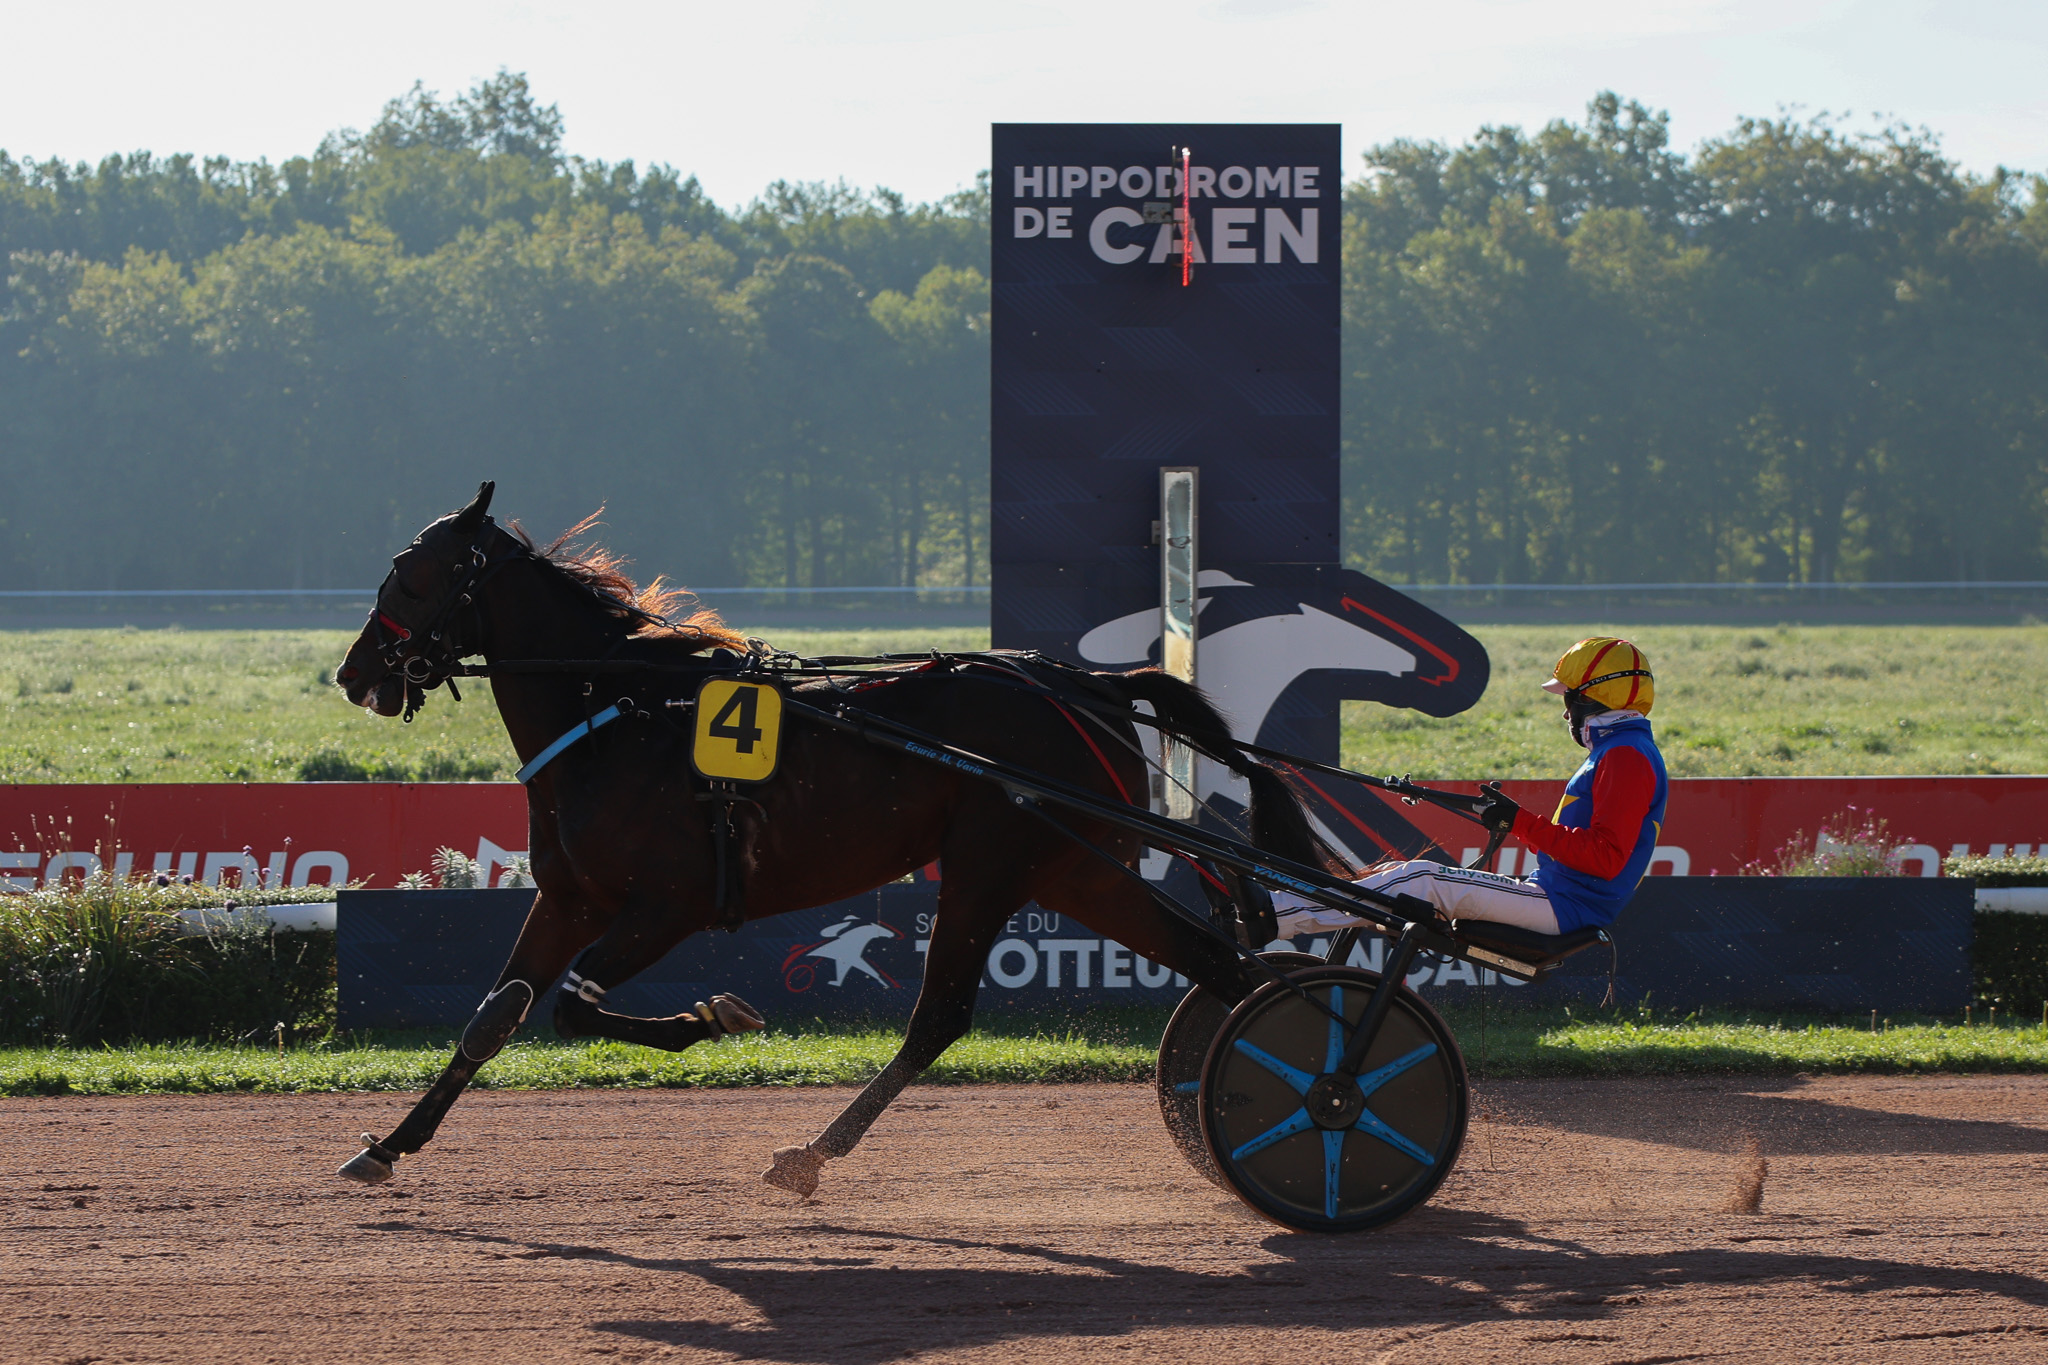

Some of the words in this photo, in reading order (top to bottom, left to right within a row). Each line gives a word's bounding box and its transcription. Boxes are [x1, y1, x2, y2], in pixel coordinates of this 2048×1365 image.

[1014, 165, 1320, 198] HIPPODROME
[1013, 207, 1073, 238] DE
[1089, 206, 1319, 264] CAEN
[709, 686, 762, 754] 4
[905, 741, 937, 759] Ecurie
[1253, 865, 1318, 894] YANKEE
[1438, 866, 1513, 886] geny.com
[1027, 912, 1060, 933] DU
